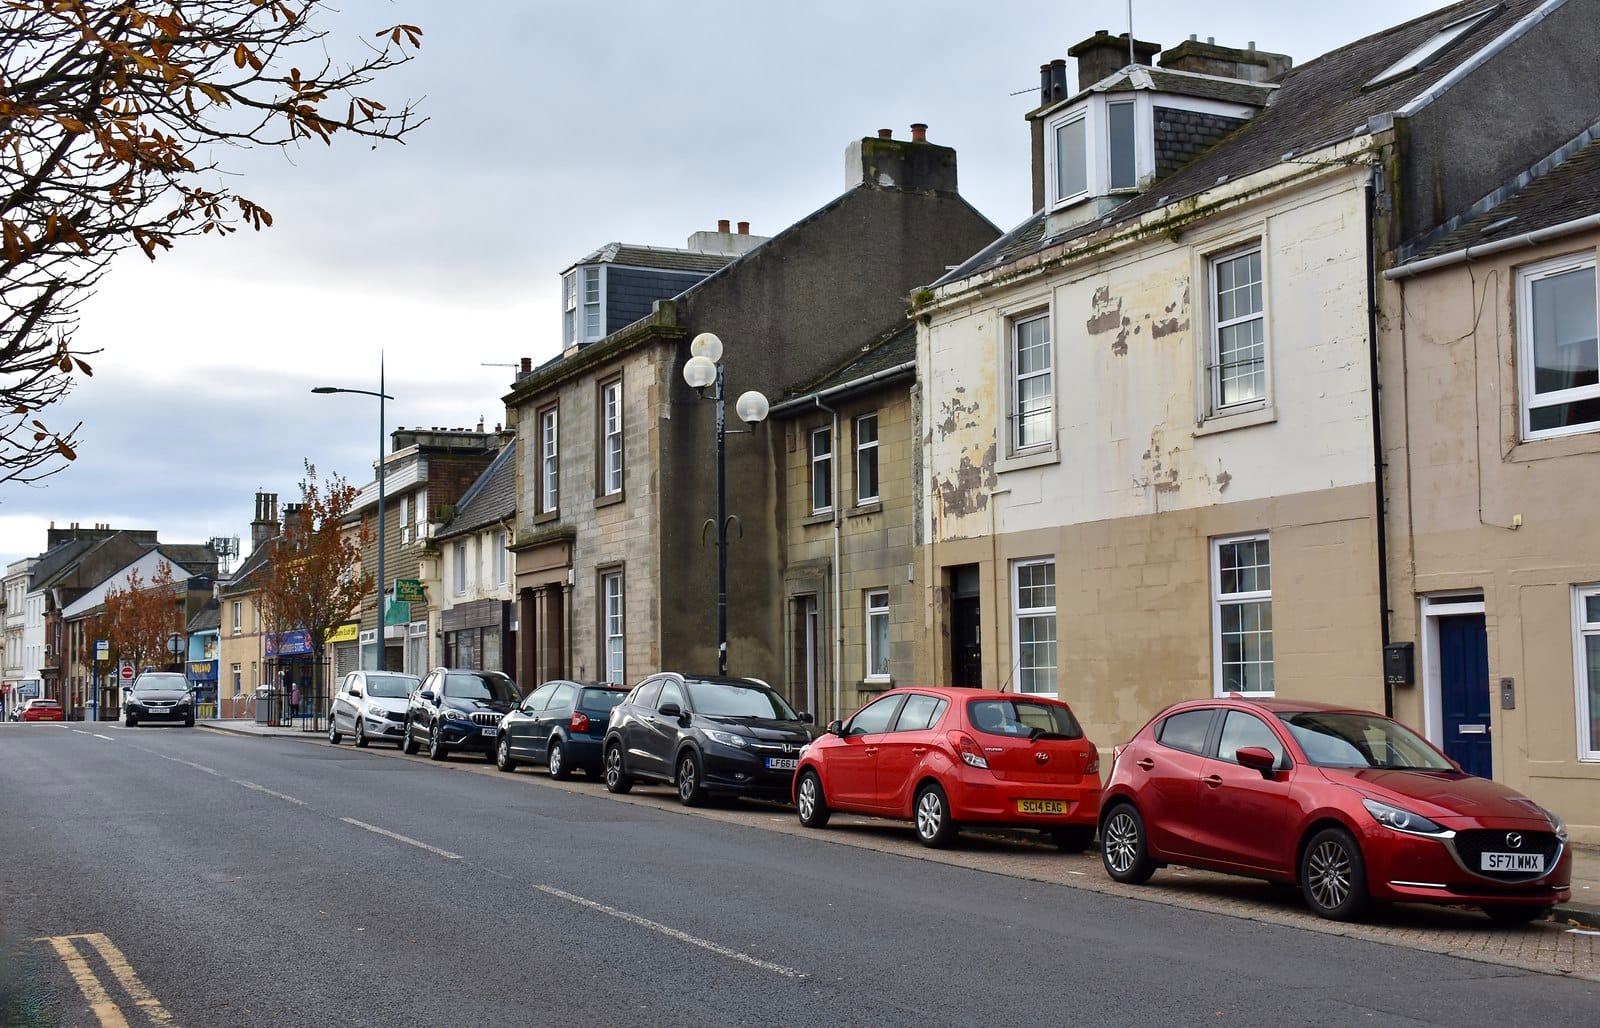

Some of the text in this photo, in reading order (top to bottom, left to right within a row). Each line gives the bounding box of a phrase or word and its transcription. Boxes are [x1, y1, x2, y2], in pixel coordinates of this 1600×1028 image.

[770, 759, 791, 768] LF66
[1023, 801, 1062, 813] SC14 EAG
[1489, 854, 1538, 869] SF71 WMX
